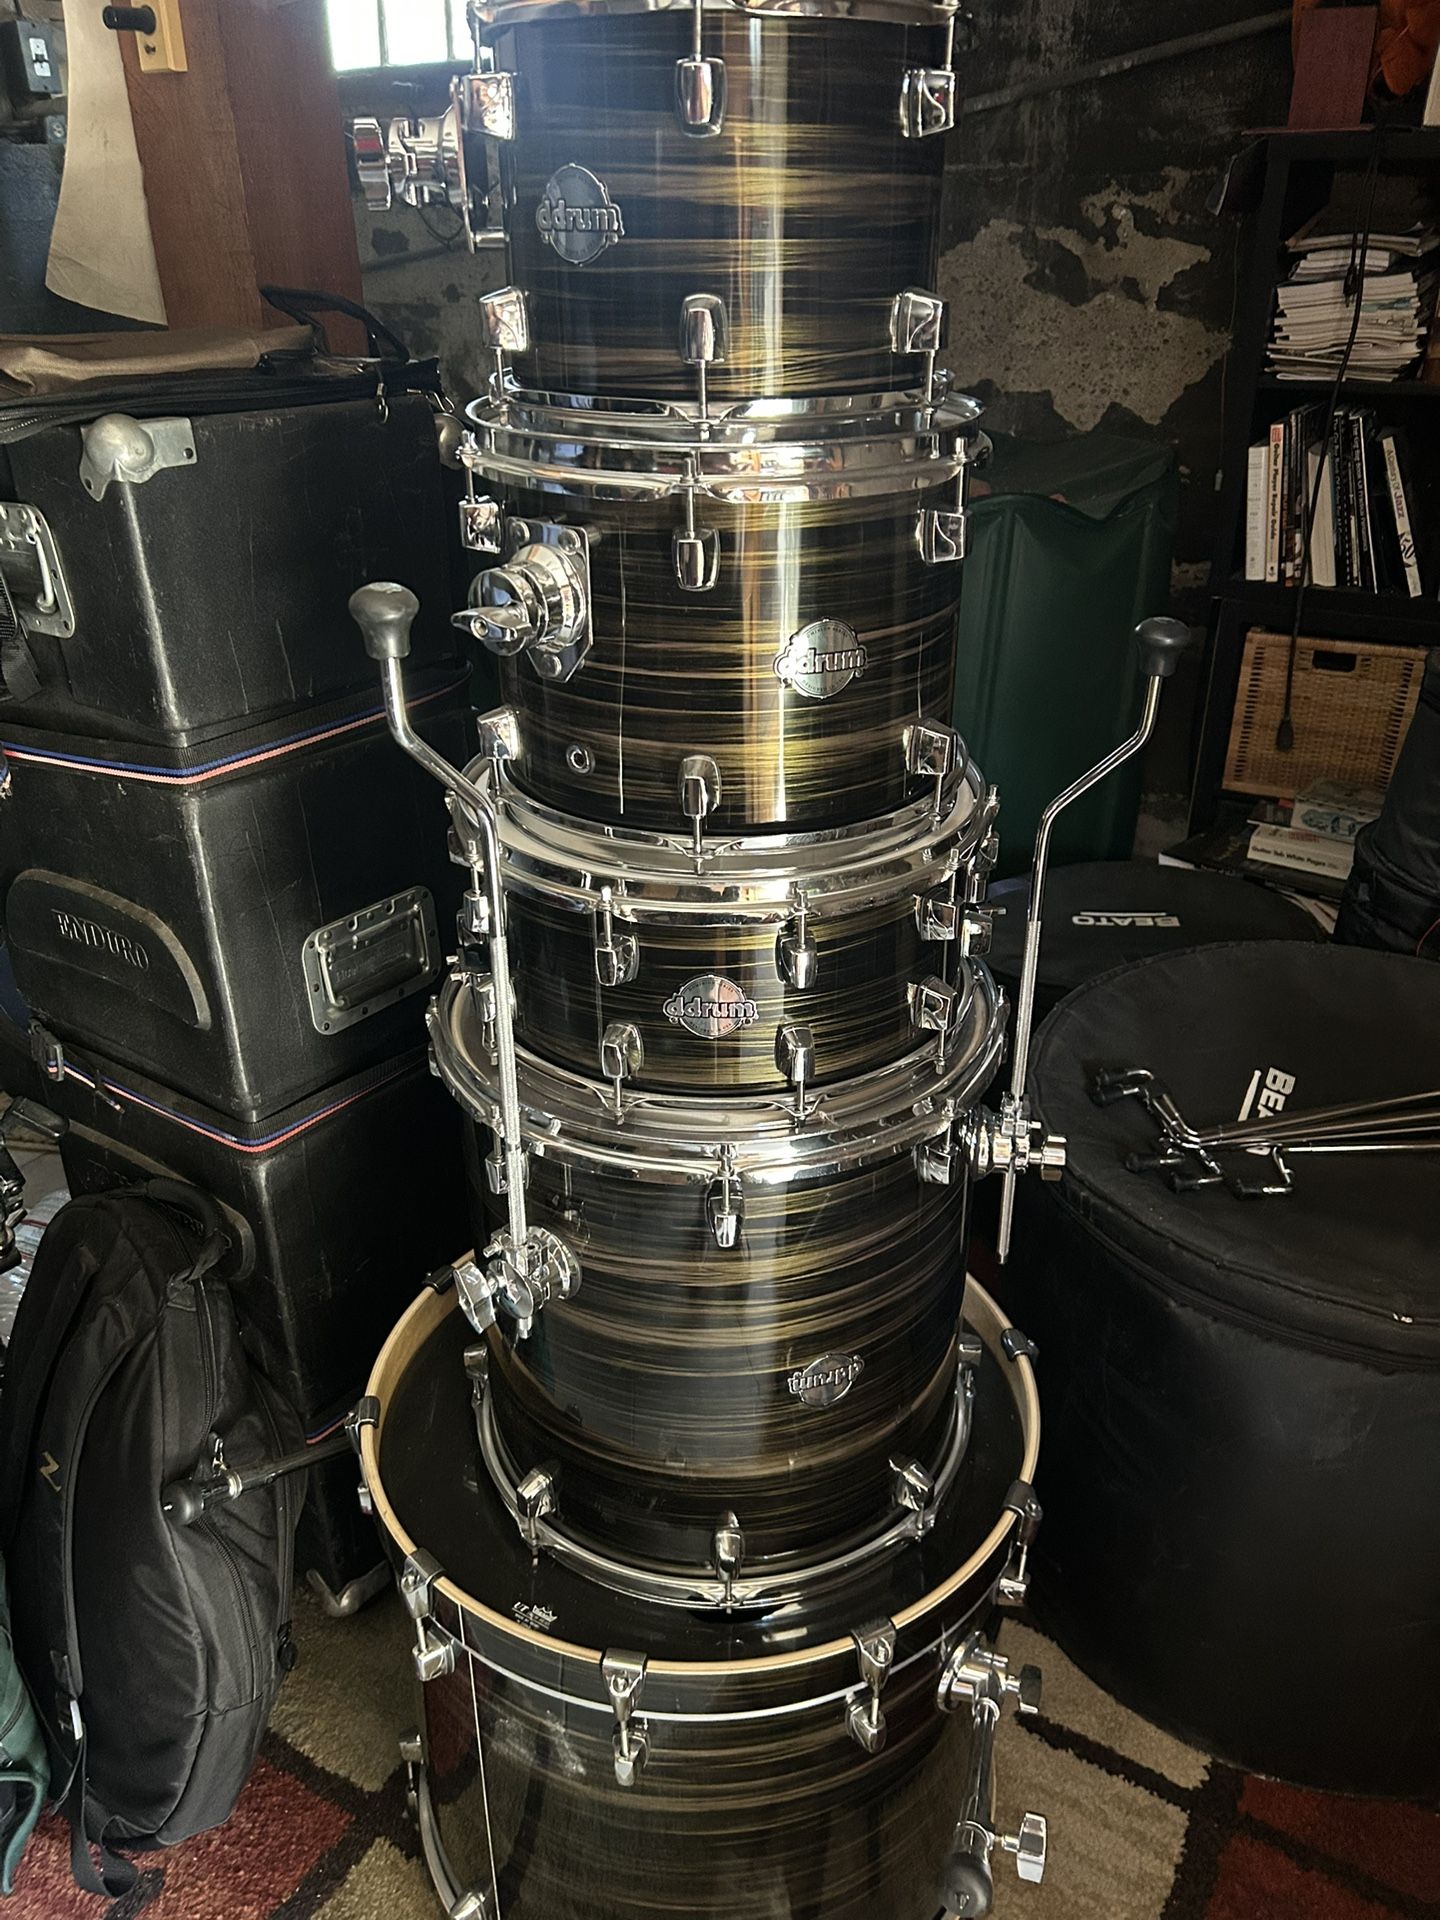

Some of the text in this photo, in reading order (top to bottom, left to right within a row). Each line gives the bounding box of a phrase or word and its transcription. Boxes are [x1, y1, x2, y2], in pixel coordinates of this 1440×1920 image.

[538, 199, 619, 231] ddrum
[1272, 443, 1280, 467] Guitar
[1271, 469, 1279, 491] Player
[1270, 493, 1278, 516] Repair
[1393, 491, 1406, 519] Jazz
[777, 646, 866, 675] ddrum
[1072, 915, 1180, 927] BEATO
[51, 908, 149, 972] ENDURO
[666, 996, 755, 1019] ddrum
